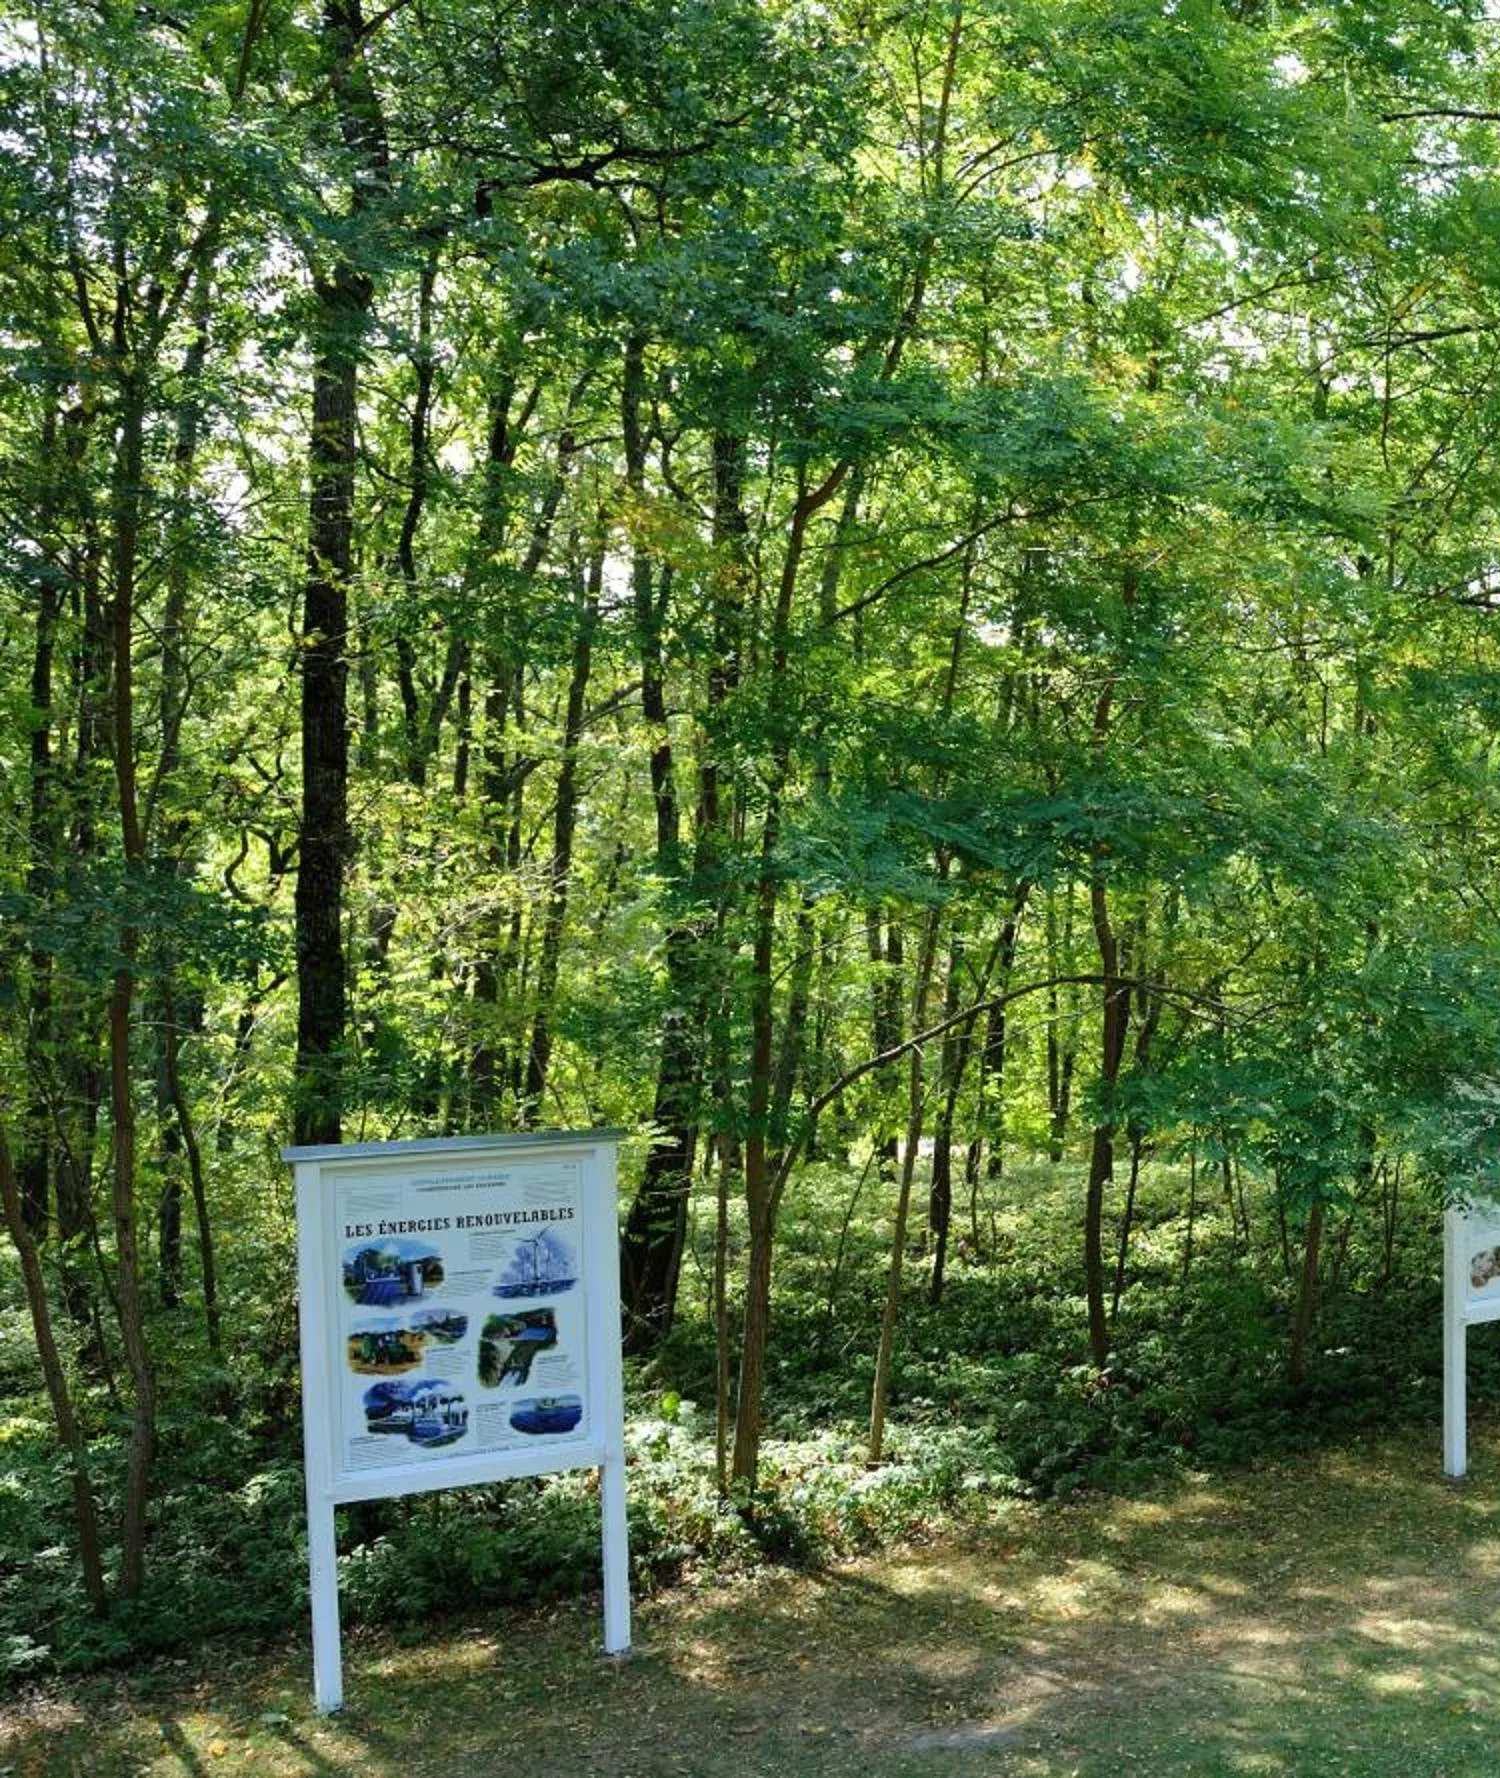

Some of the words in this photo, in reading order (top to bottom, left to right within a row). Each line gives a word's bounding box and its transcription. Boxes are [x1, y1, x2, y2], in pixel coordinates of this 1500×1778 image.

[345, 1223, 373, 1239] LES
[379, 1218, 450, 1235] ÉNERGIES
[456, 1207, 575, 1229] RENOUVELABLES
